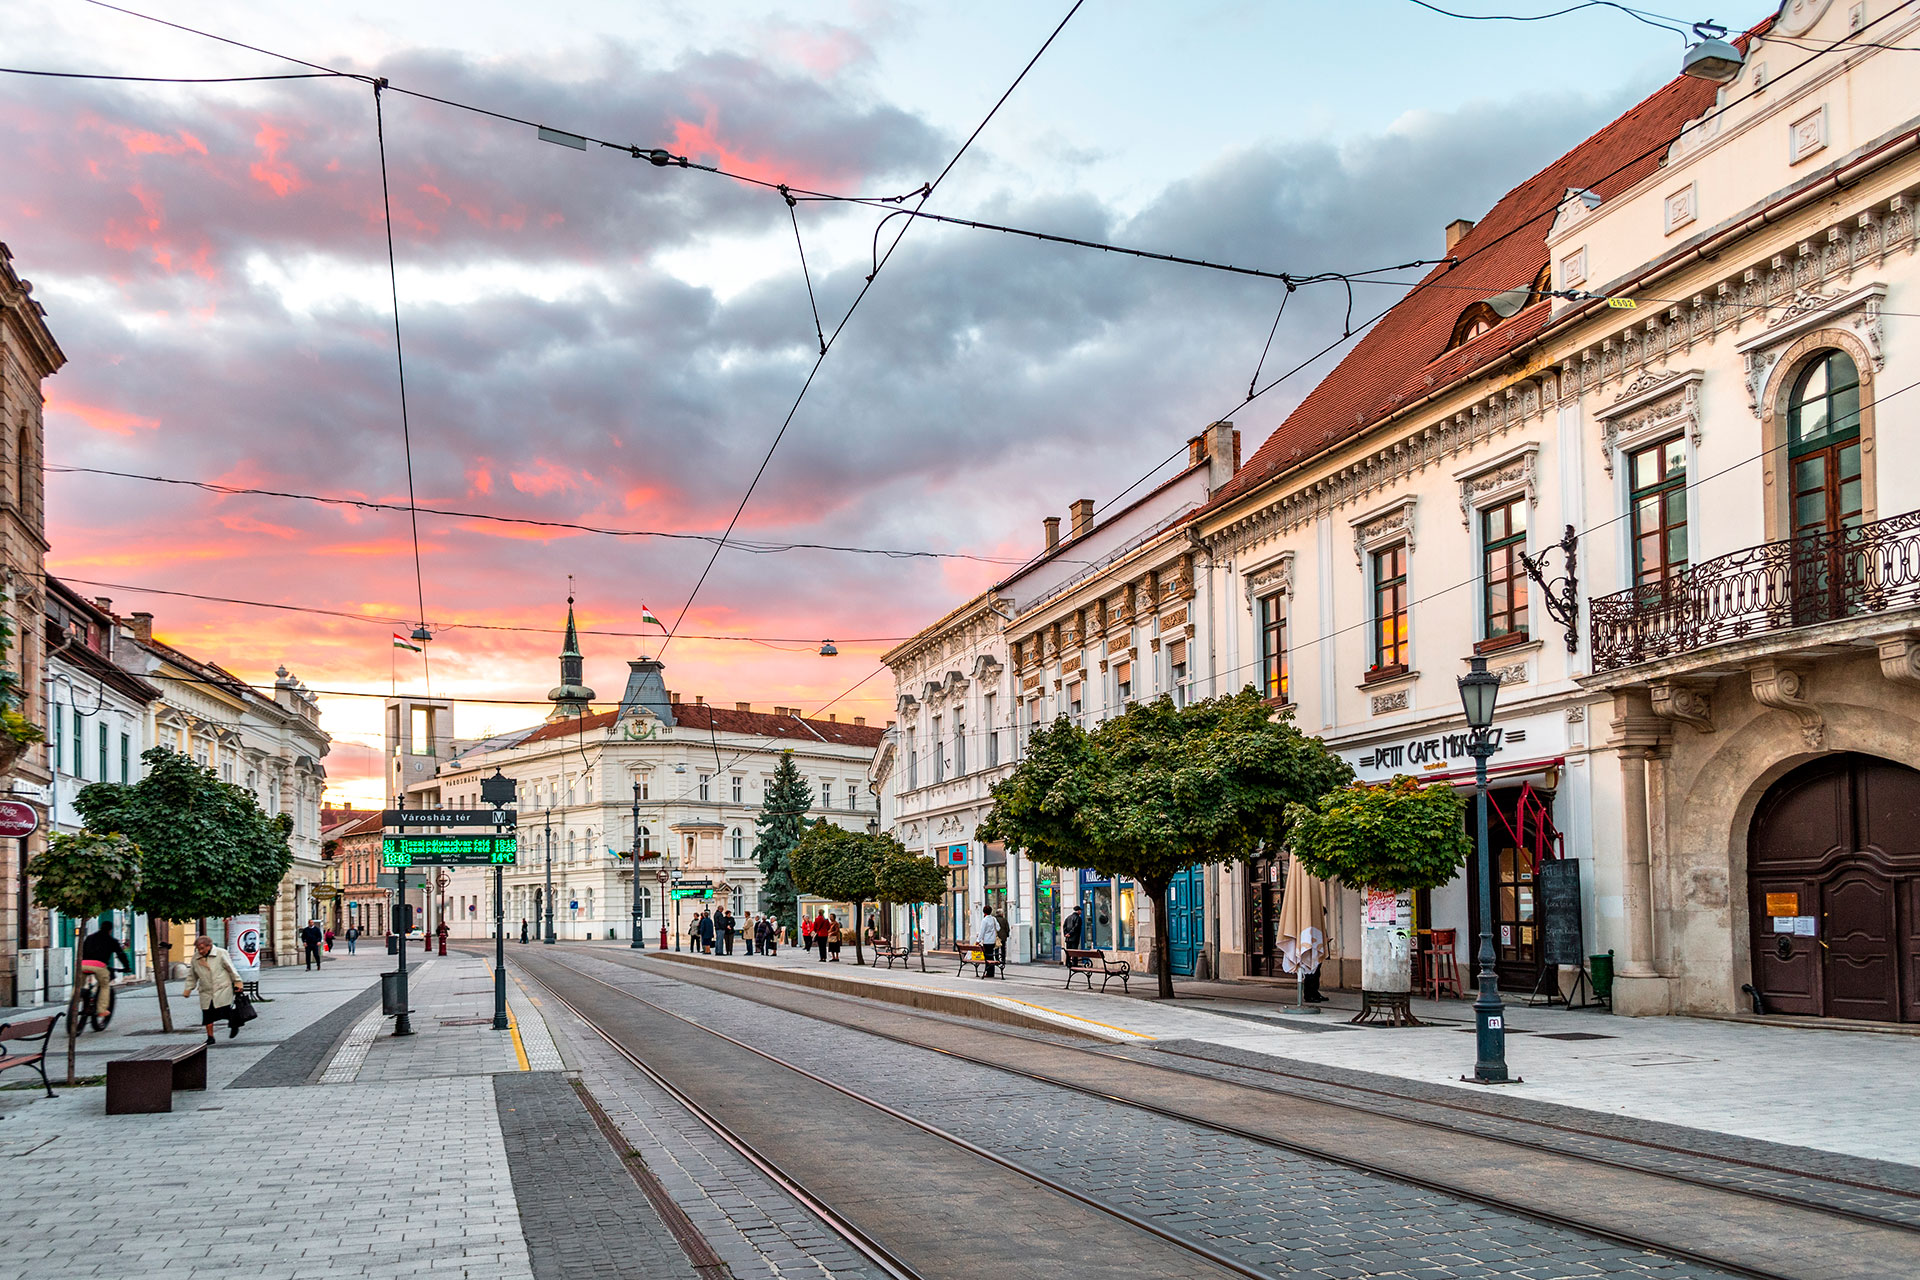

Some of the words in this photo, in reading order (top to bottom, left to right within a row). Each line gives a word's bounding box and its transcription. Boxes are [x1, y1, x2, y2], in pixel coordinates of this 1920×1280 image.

[1375, 745, 1404, 770] PETIT
[1408, 739, 1439, 765] CAFE
[1442, 728, 1503, 759] MISKOCZ
[401, 813, 452, 821] Városház
